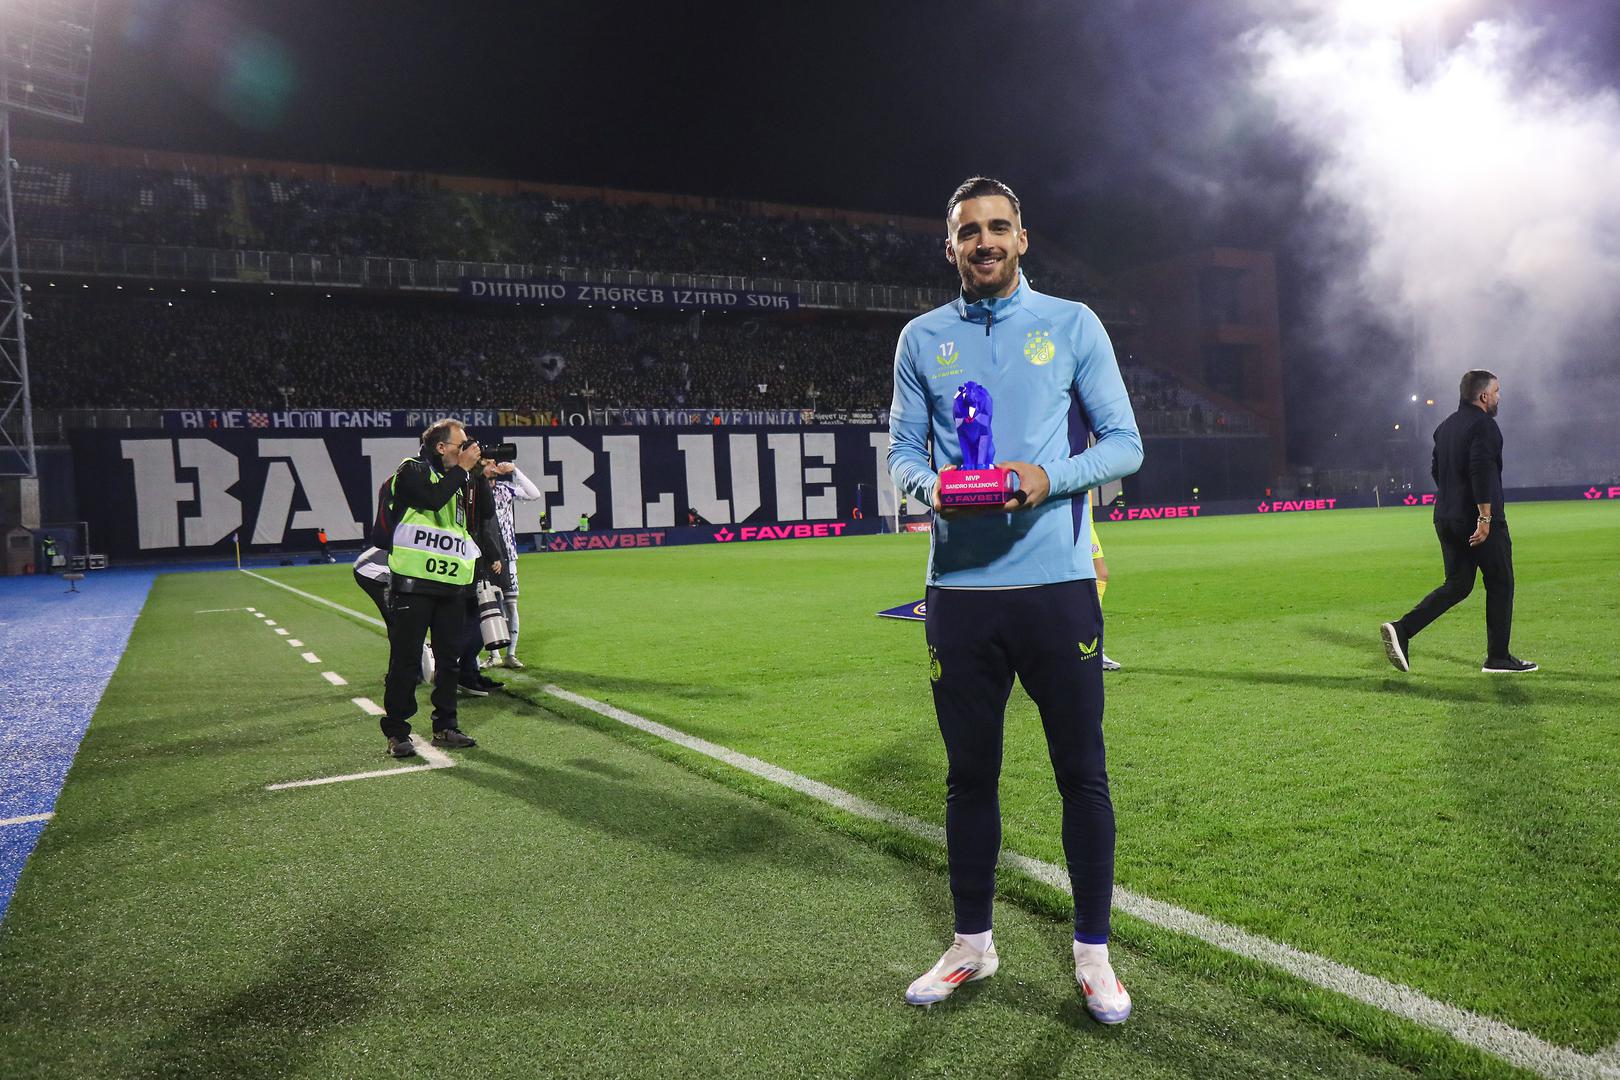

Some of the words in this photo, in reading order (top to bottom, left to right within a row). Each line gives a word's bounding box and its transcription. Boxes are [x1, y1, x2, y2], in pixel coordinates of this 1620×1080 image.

[471, 281, 565, 299] DINAMO
[578, 286, 664, 303] ZAGREB
[673, 291, 737, 306] IZNAD
[939, 341, 955, 357] 17
[503, 433, 837, 533] BLUE
[968, 481, 999, 489] KULENOVIĆ
[955, 494, 1000, 502] FAVBET
[1272, 499, 1336, 512] FAVBET
[1127, 505, 1200, 520] FAVBET
[577, 532, 665, 549] FAVBET
[740, 523, 846, 541] FAVBET
[414, 530, 466, 557] PHOTO
[425, 558, 459, 577] 032
